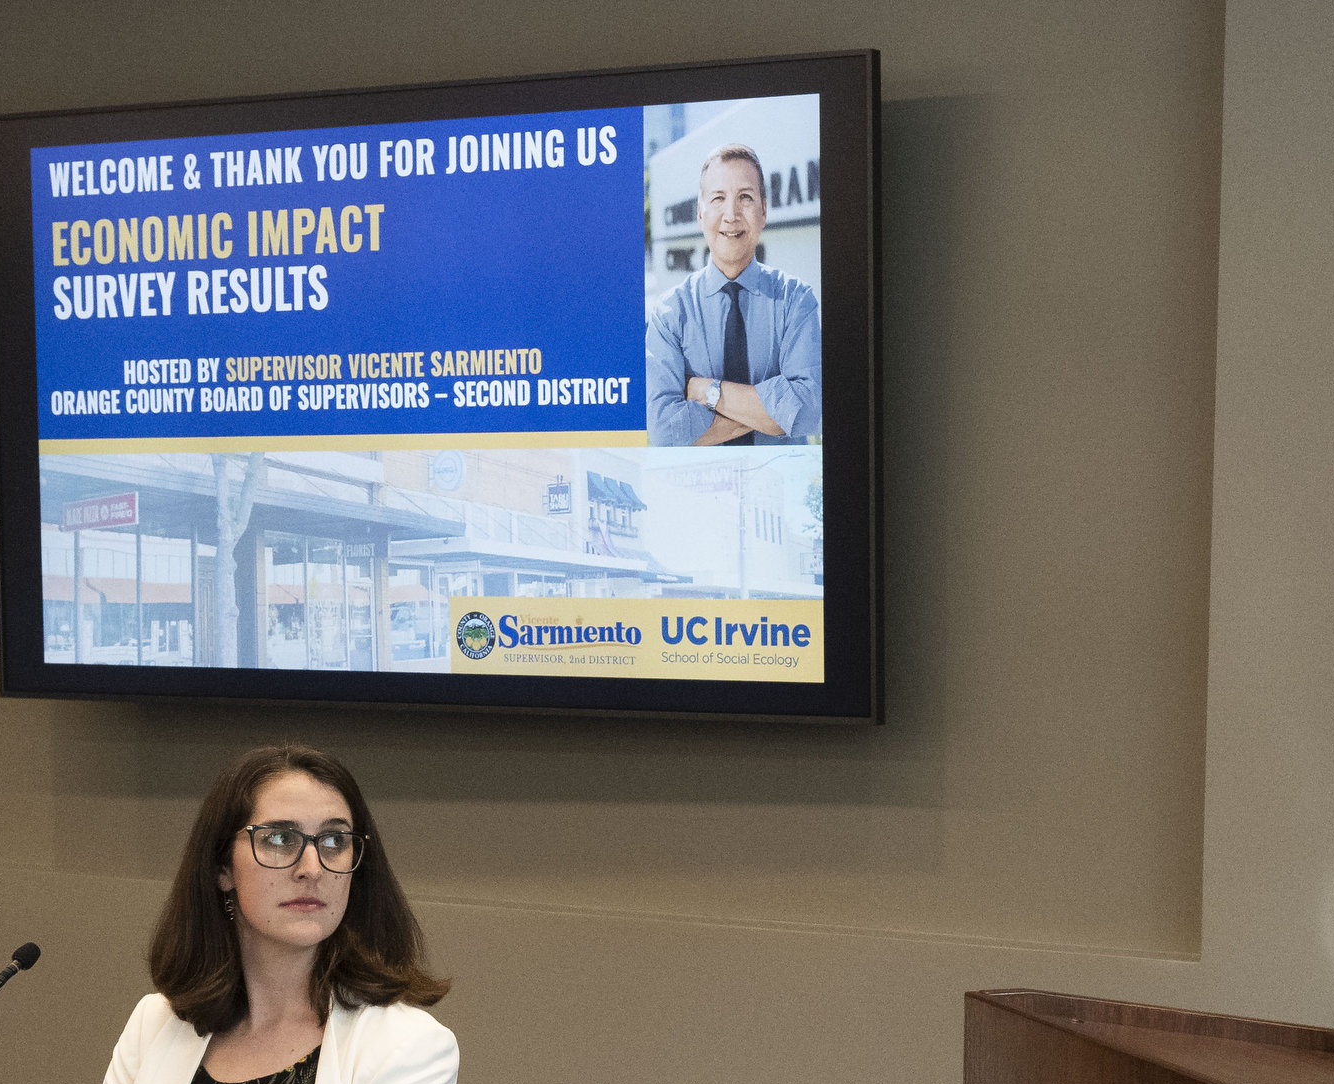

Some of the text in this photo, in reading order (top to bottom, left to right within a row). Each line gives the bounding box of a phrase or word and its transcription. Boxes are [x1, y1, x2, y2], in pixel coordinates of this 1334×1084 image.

[49, 125, 618, 198] WELCOME & THANK YOU FOR JOINING US
[52, 204, 385, 266] ECONOMIC IMPACT
[53, 264, 329, 320] SURVEY RESULTS
[123, 347, 542, 385] HOSTED BY SUPERVISOR VICENTE SARMIENTO
[51, 389, 121, 415] ORANGE
[125, 387, 194, 413] COUNTY
[200, 385, 264, 412] BOARD
[269, 384, 293, 411] OF
[297, 381, 430, 410] SUPERVISORS
[453, 380, 532, 408] SECOND
[537, 377, 631, 405] DISTRICT
[457, 614, 471, 639] COUNTY
[498, 614, 642, 649] Sarmiento
[519, 614, 560, 625] Vicente
[661, 616, 811, 648] UC Irvine
[503, 653, 637, 666] SUPERVISOR, 2nd DISTRICT
[661, 651, 800, 668] School of Social Ecology
